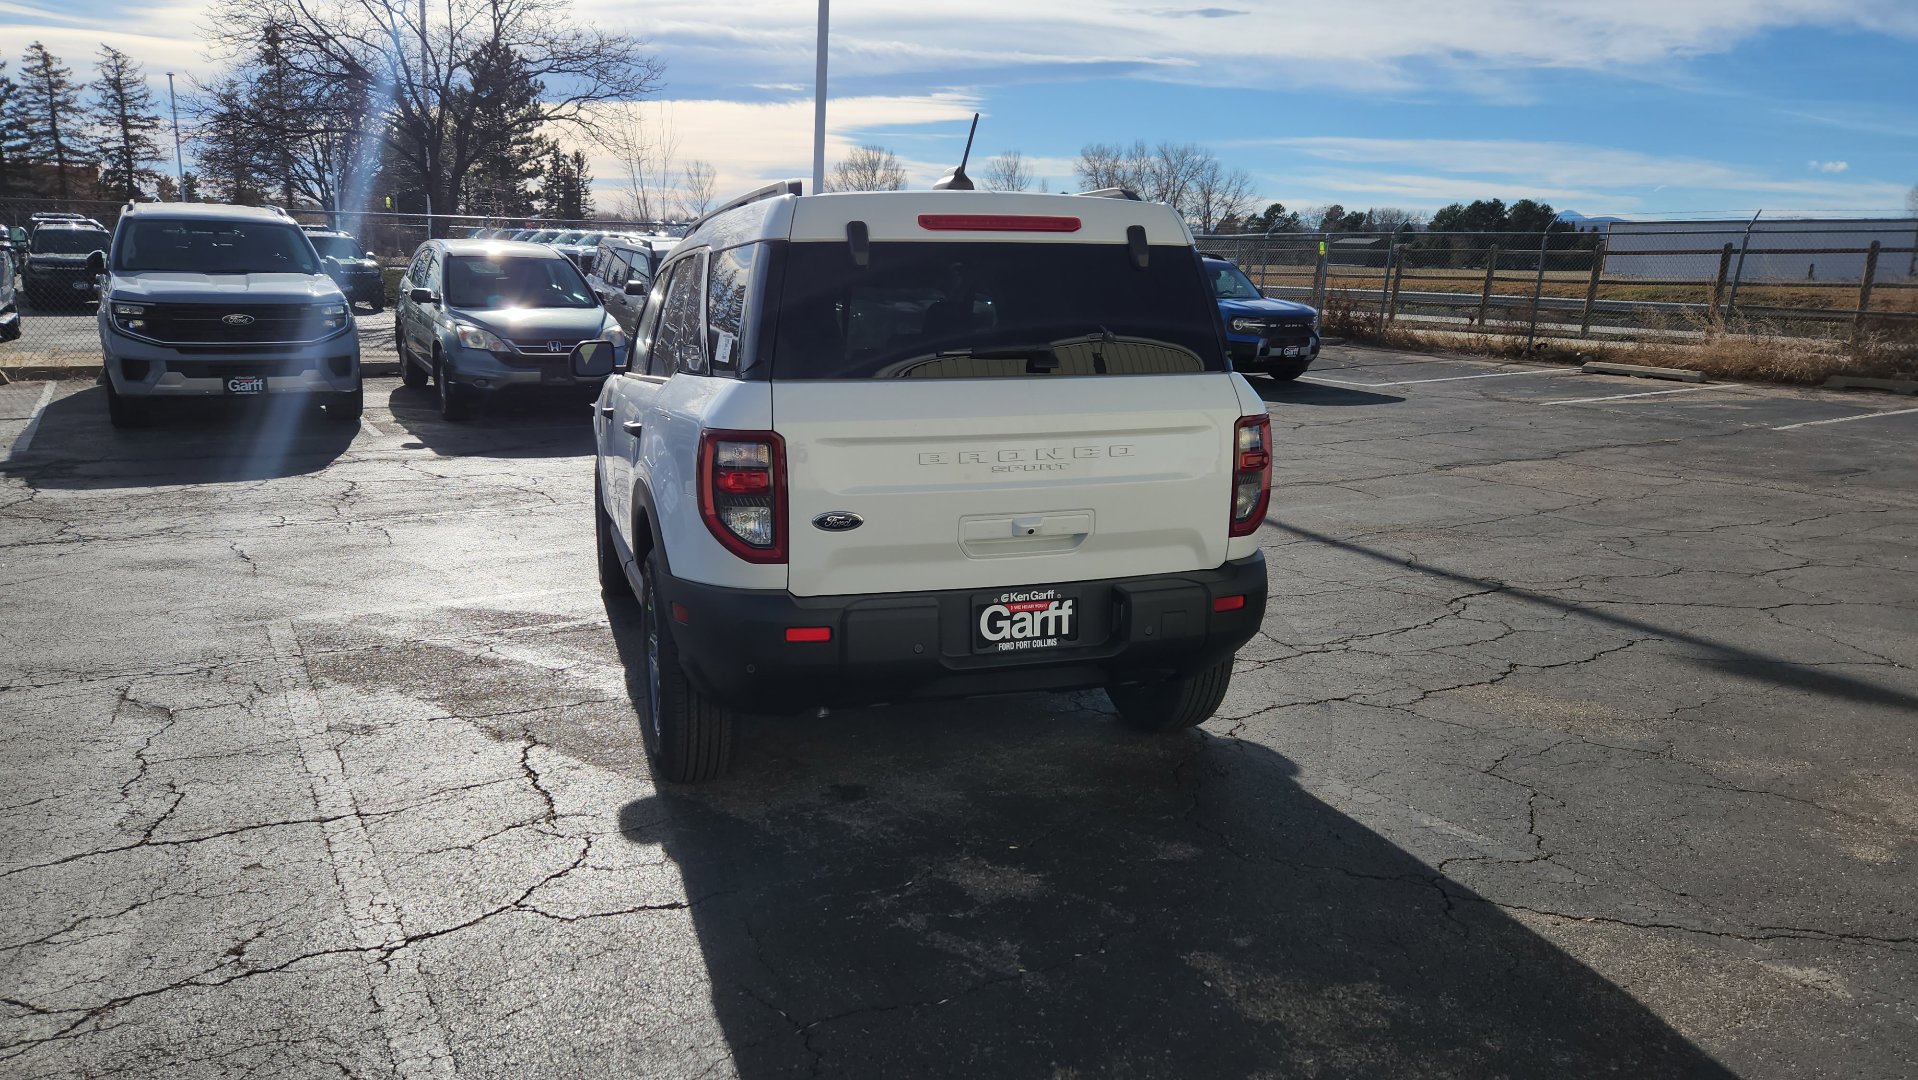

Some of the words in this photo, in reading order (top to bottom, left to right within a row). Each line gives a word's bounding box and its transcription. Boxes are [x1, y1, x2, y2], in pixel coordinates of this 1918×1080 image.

[228, 379, 263, 392] Garff
[918, 444, 1135, 466] BRONCO
[991, 462, 1070, 473] SPORT
[1010, 592, 1031, 602] Ken
[1030, 590, 1055, 601] Garff
[980, 599, 1073, 641] Garff
[998, 641, 1015, 652] FORD
[1015, 640, 1031, 650] FORT
[1032, 638, 1058, 648] COLLINS
